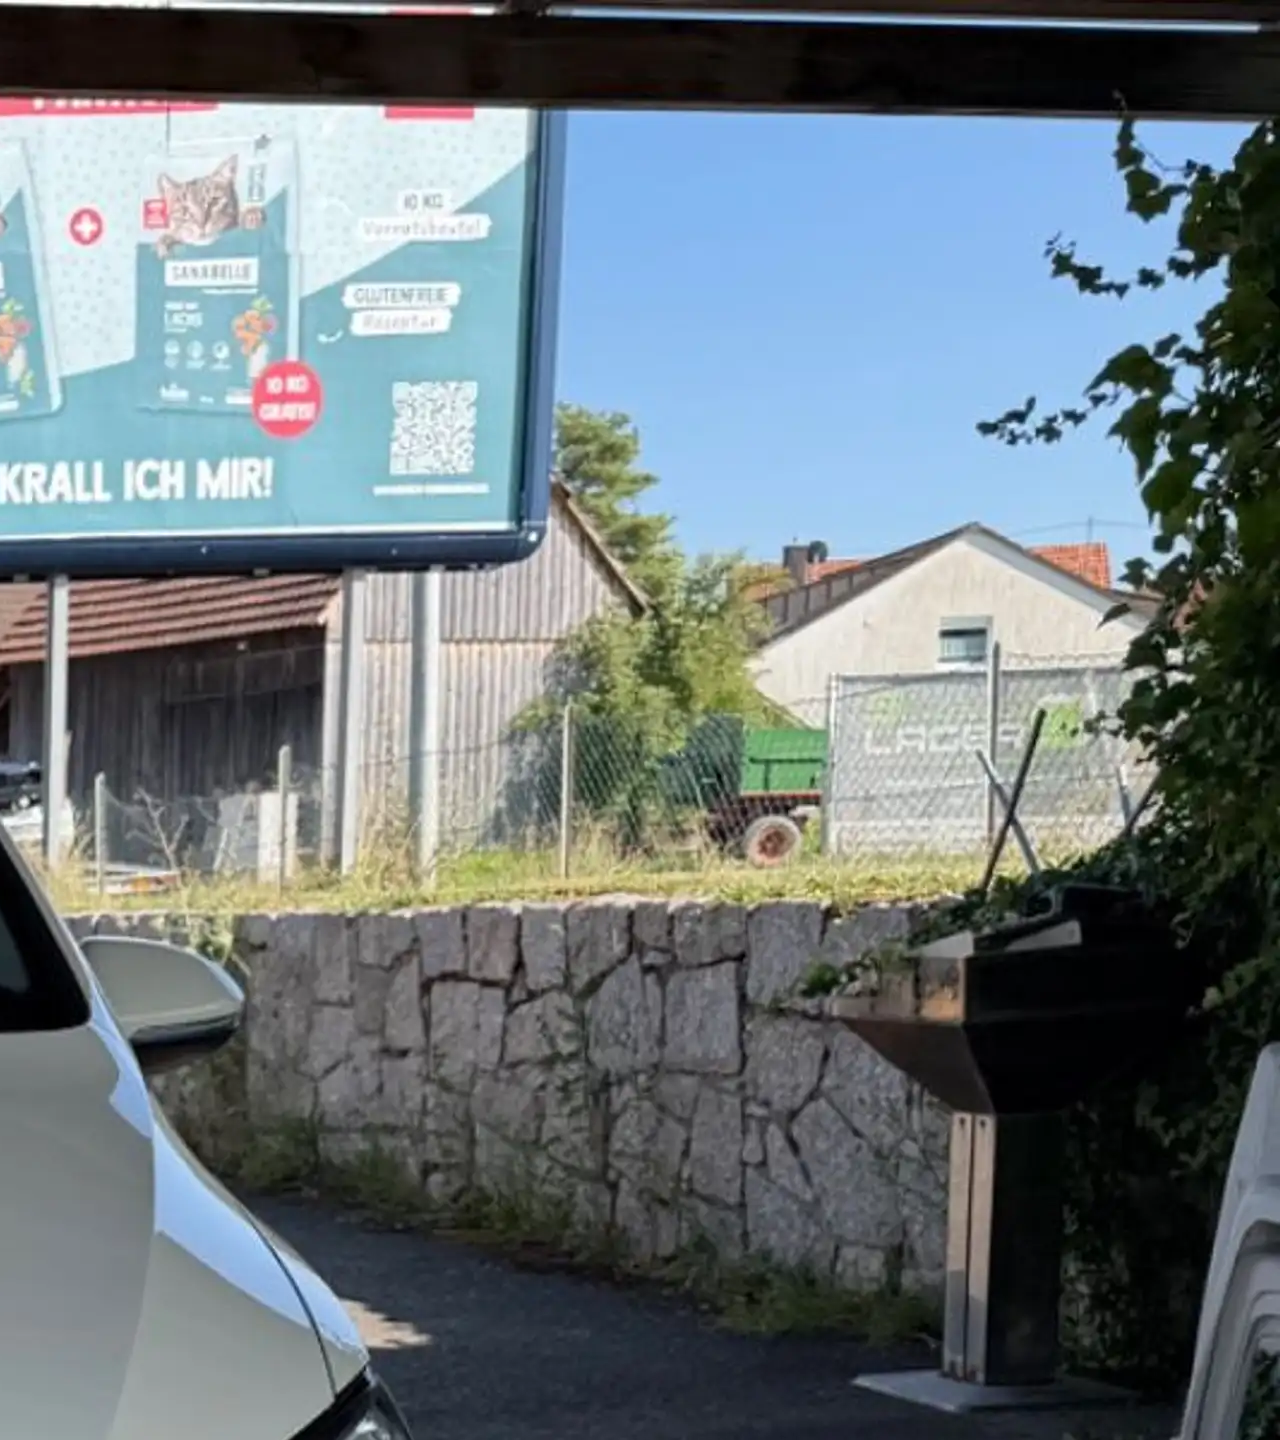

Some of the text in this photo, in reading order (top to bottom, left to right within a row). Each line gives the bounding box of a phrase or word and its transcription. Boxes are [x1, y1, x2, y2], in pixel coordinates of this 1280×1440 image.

[172, 264, 252, 281] SANABELLE
[123, 459, 186, 501] ICH
[196, 457, 273, 499] MIR!
